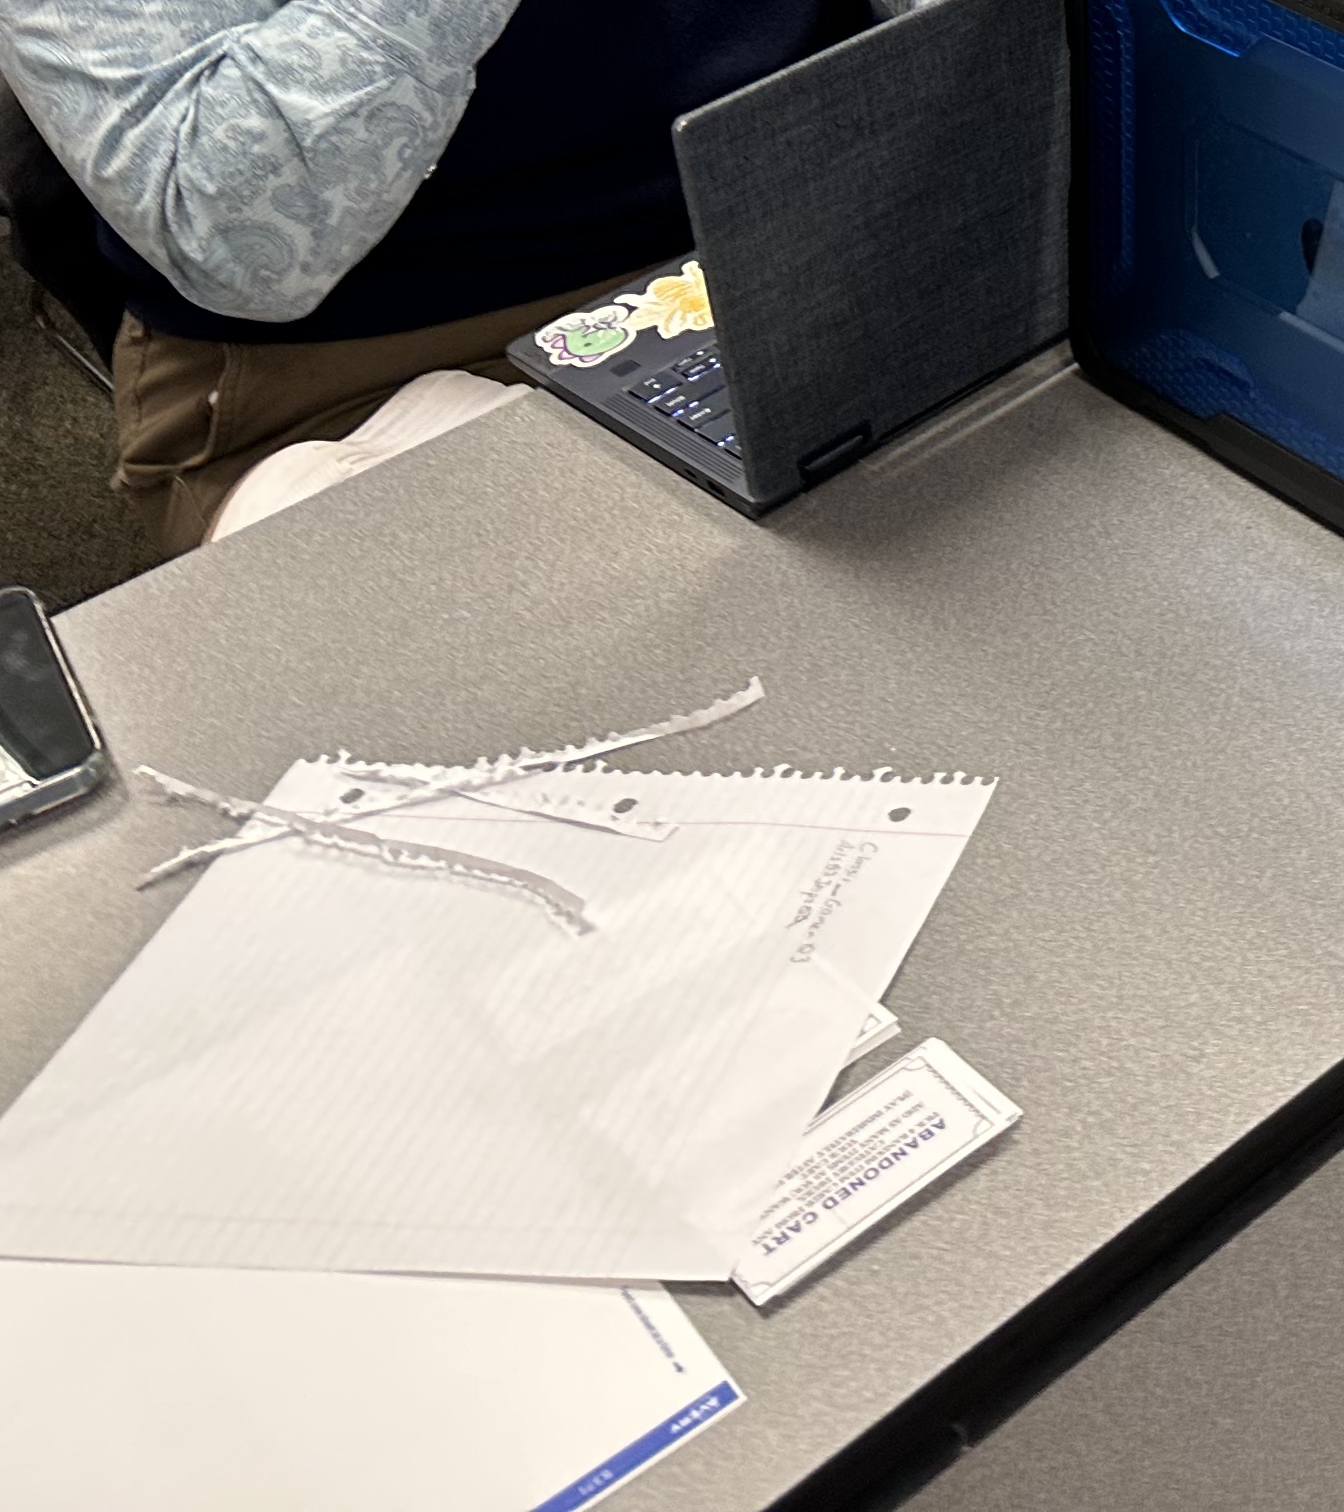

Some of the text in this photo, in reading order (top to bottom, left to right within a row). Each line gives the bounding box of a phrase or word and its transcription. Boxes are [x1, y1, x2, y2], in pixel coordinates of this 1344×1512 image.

[761, 1117, 947, 1256] ABANDONED CART
[669, 1395, 721, 1434] AVERY
